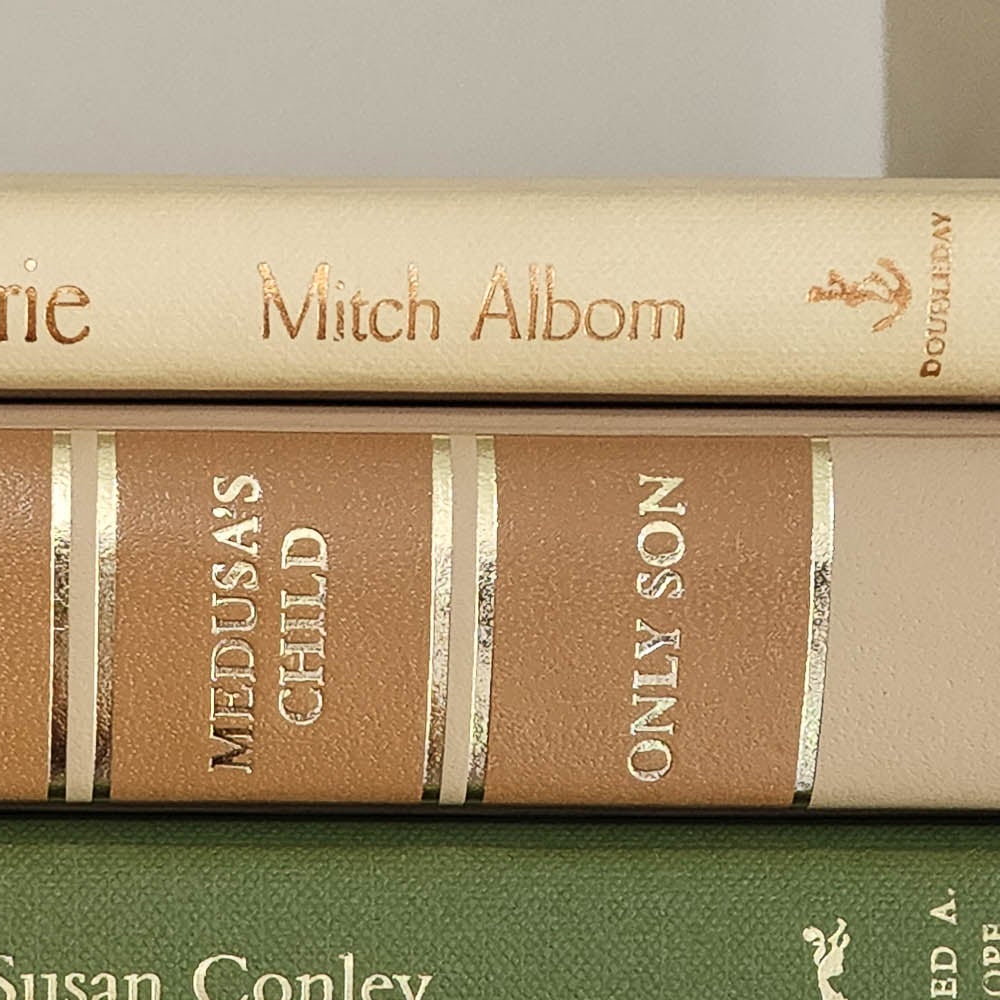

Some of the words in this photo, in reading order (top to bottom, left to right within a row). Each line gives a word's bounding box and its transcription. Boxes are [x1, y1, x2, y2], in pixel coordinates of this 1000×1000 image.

[258, 262, 440, 342] Mitch
[470, 262, 687, 342] Albom
[636, 473, 687, 600] SON
[208, 473, 261, 774] MEDUSA'S
[278, 526, 329, 726] CHILD
[626, 618, 682, 782] ONLY
[930, 887, 958, 926] A.
